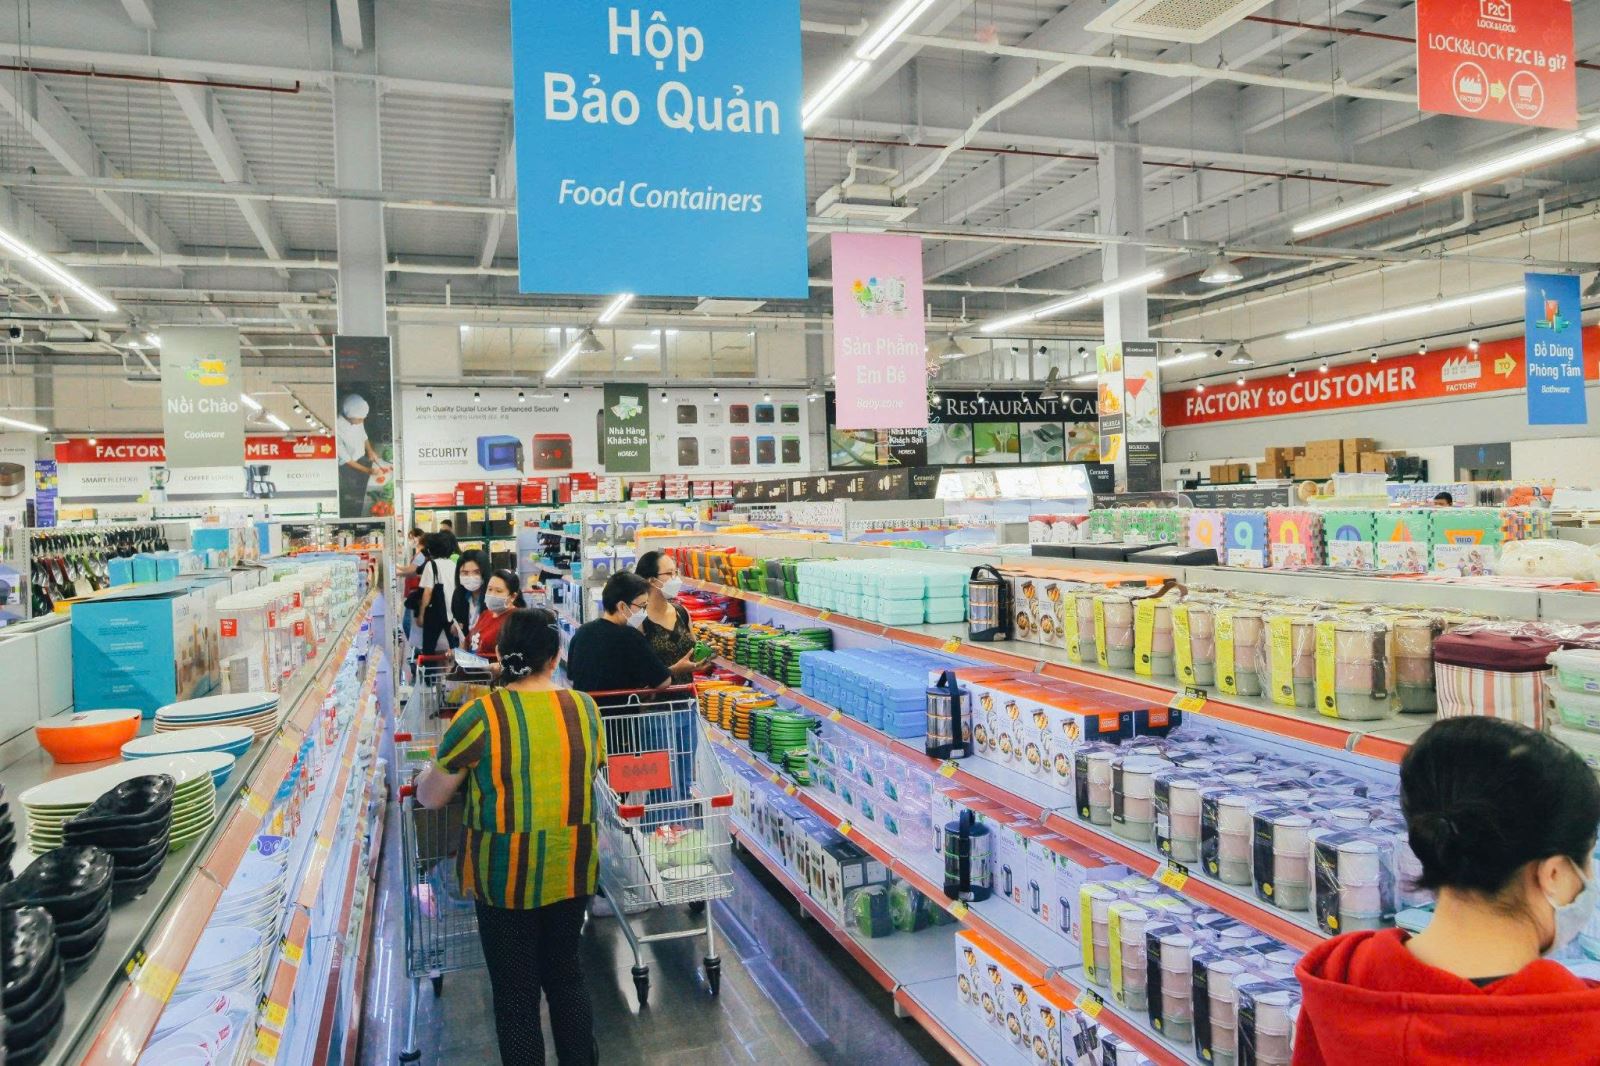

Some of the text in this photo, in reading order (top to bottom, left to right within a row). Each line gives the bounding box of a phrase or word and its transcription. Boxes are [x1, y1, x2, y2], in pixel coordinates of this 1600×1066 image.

[1487, 4, 1506, 17] F2C
[1477, 20, 1517, 33] LOCK&LOCK
[608, 7, 704, 72] Hộp
[1428, 33, 1567, 72] LOCK&LOCK F2C là gì?
[544, 72, 780, 135] Bảo Quản
[558, 179, 762, 213] Food Containers
[842, 336, 871, 356] Sản
[1534, 340, 1574, 362] Đồ Dùng
[856, 364, 906, 384] Em Bé
[1529, 361, 1559, 380] Phòng
[1186, 366, 1417, 418] FACTORY to CUSTOMER
[1446, 381, 1477, 392] FACTORY
[1541, 385, 1571, 393] Bathware
[167, 395, 238, 414] Nồi Chảo
[946, 398, 1060, 416] RESTAURANT
[184, 430, 225, 439] Cookware
[609, 426, 646, 437] Nhà Hàng
[911, 436, 924, 445] Sạn
[607, 436, 648, 446] Khách Sạn
[96, 445, 166, 458] FACTORY
[418, 448, 468, 458] SECURITY
